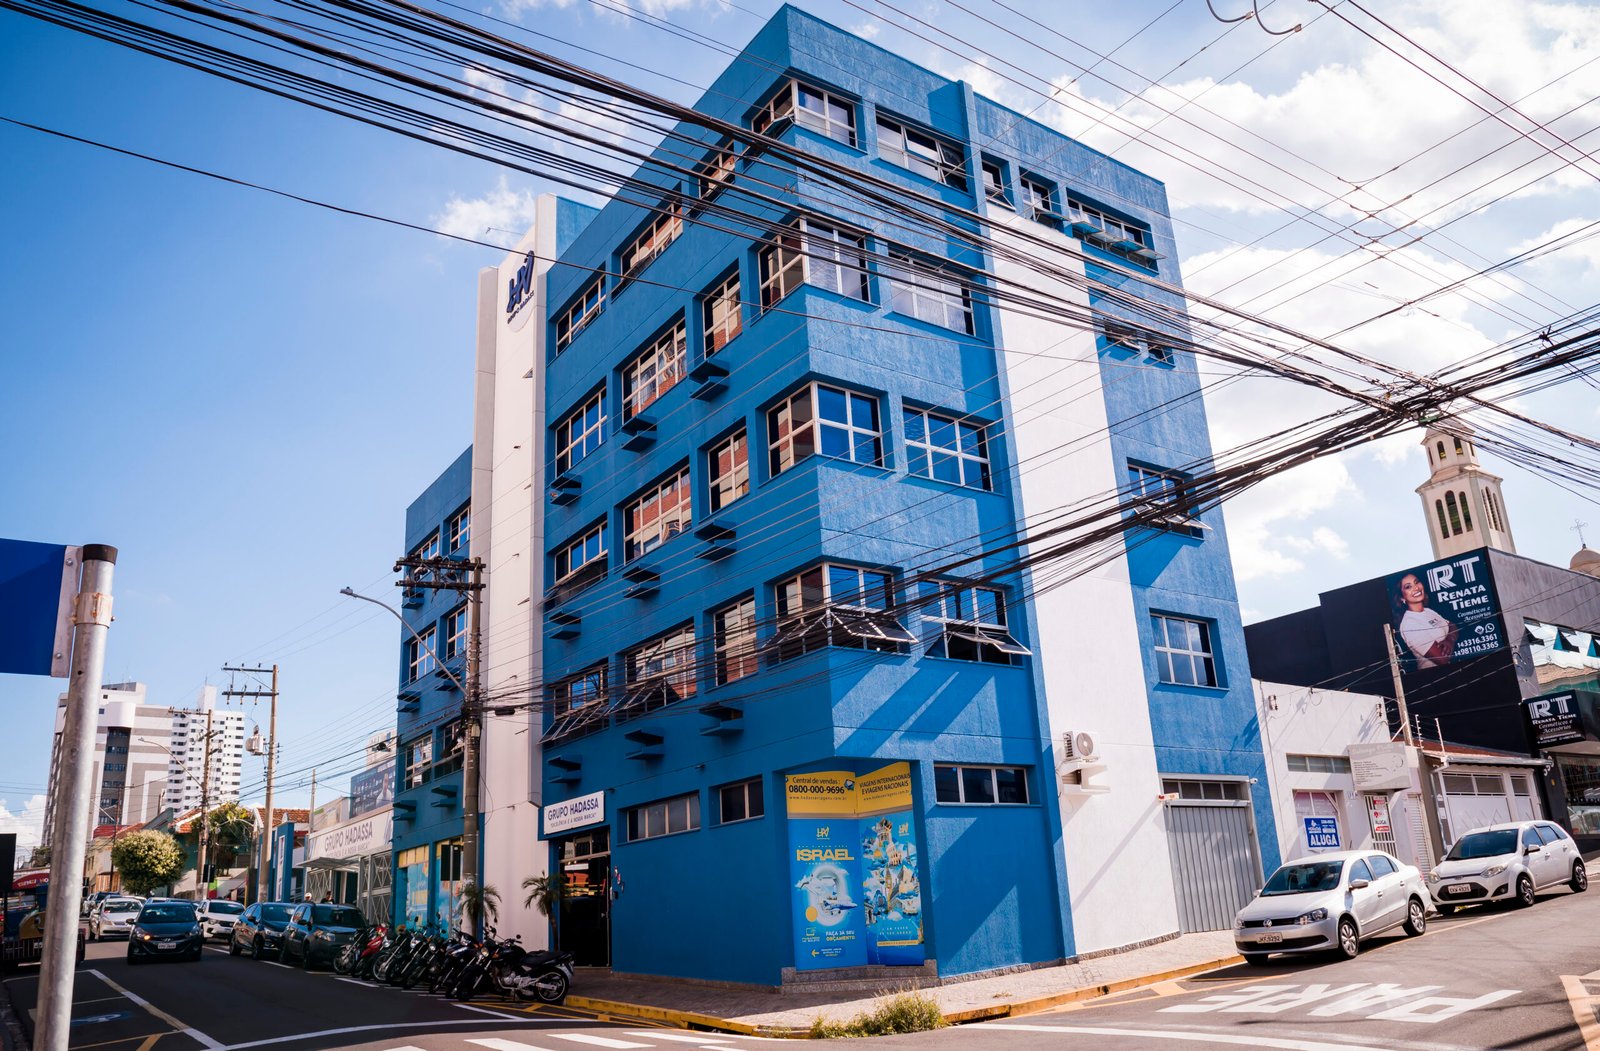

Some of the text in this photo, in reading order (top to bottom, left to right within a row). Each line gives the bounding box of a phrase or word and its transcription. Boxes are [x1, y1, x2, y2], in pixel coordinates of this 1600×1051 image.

[792, 776, 811, 784] Central
[860, 772, 910, 788] VIAGENS INTERNACIONAIS
[865, 785, 883, 793] VIAGENS
[884, 780, 908, 790] NACIONAIS
[789, 785, 845, 794] 0800-000-9696
[547, 797, 599, 821] GRUPO HADASSA
[324, 821, 373, 852] GRUPO HADASSA
[1310, 834, 1338, 846] ALUGA
[796, 848, 855, 861] ISRAEL
[1156, 983, 1522, 1024] PARE
